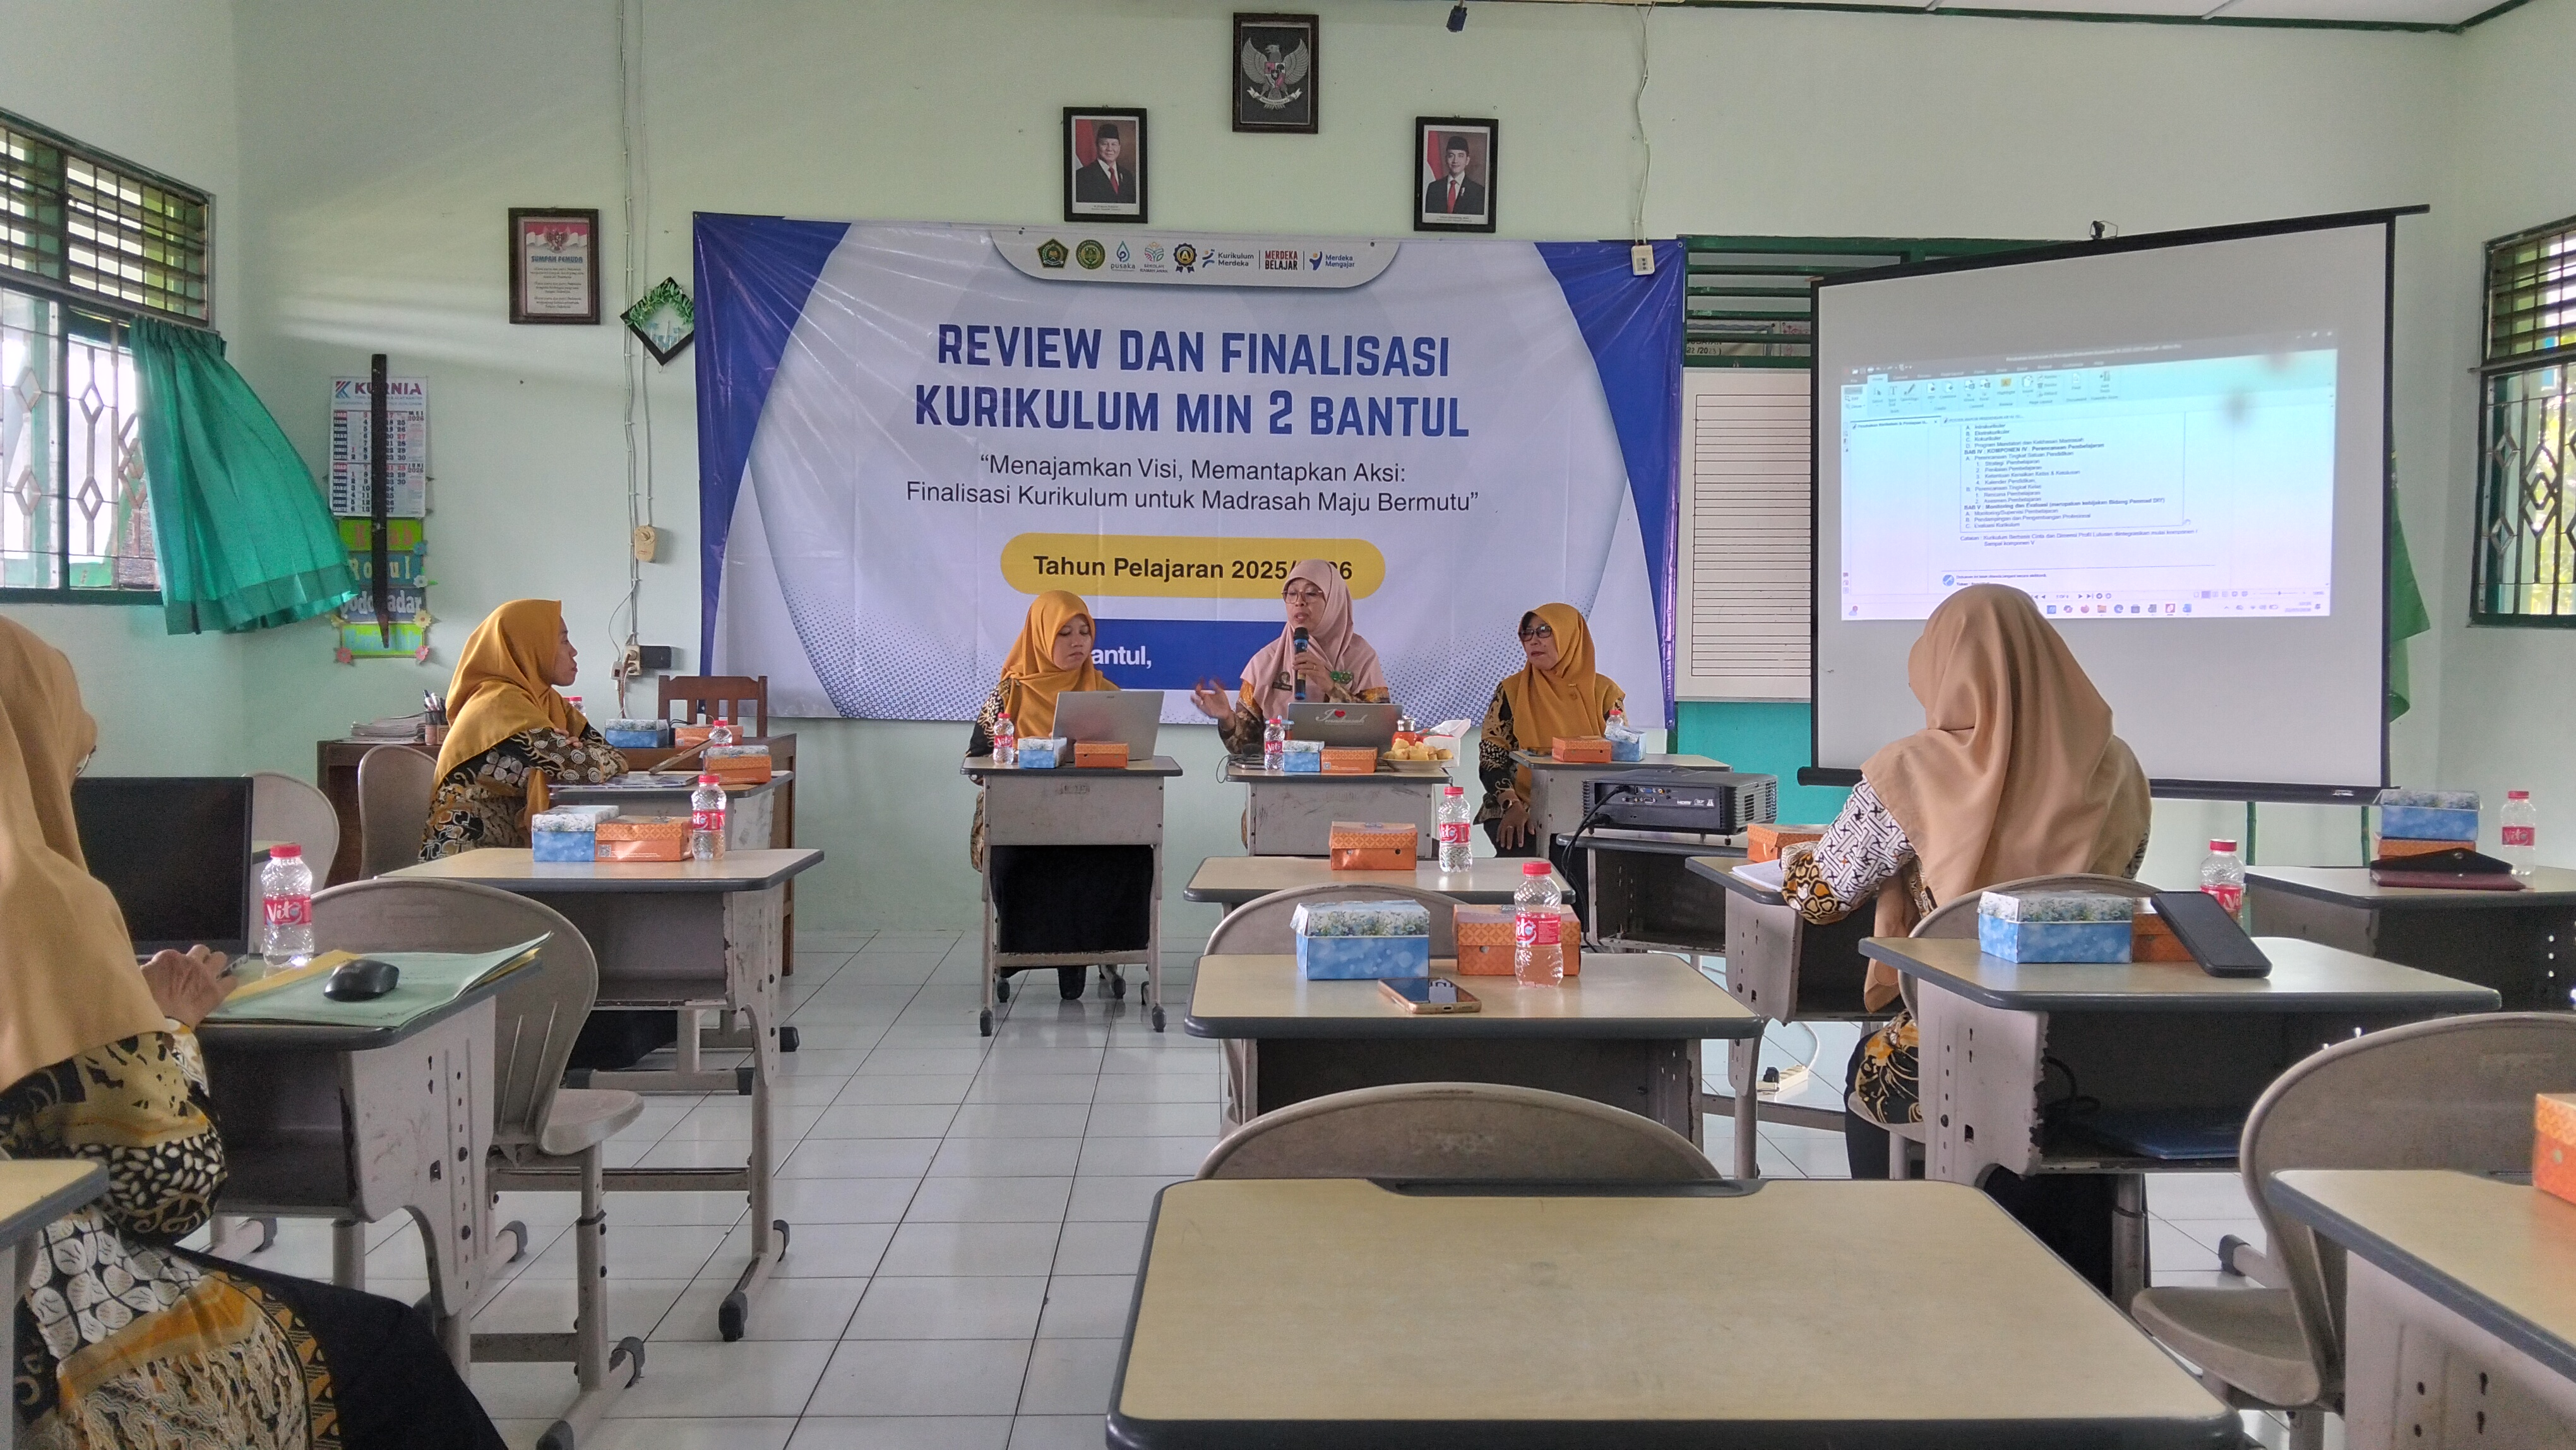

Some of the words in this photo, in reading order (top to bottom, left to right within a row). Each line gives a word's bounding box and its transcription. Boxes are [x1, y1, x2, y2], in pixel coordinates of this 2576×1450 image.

[1265, 250, 1298, 260] MERDEKA
[1265, 260, 1298, 270] BELAJAR
[938, 323, 1102, 369] REVIEW
[1119, 329, 1204, 373] DAN
[1222, 332, 1449, 377] FINALISASI
[916, 384, 1159, 431] KURIKULUM
[1176, 393, 1251, 434] MIN
[1269, 390, 1292, 434] 2
[1311, 396, 1469, 437] BANTUL
[981, 454, 1131, 480] “Menajamkan
[1138, 458, 1183, 481] Visi,
[1191, 459, 1346, 486] Memantapkan
[1353, 462, 1405, 482] Aksi:
[907, 481, 1010, 504] Finalisasi
[1018, 485, 1127, 507] Kurikulum
[1135, 490, 1195, 509] untuk
[1202, 490, 1310, 510] Madrasah
[1318, 492, 1370, 516] Maju
[1378, 492, 1478, 512] Bermutu”
[1033, 555, 1105, 576] Tahun
[1114, 558, 1224, 582] Pelajaran
[1090, 645, 1152, 669] antul,
